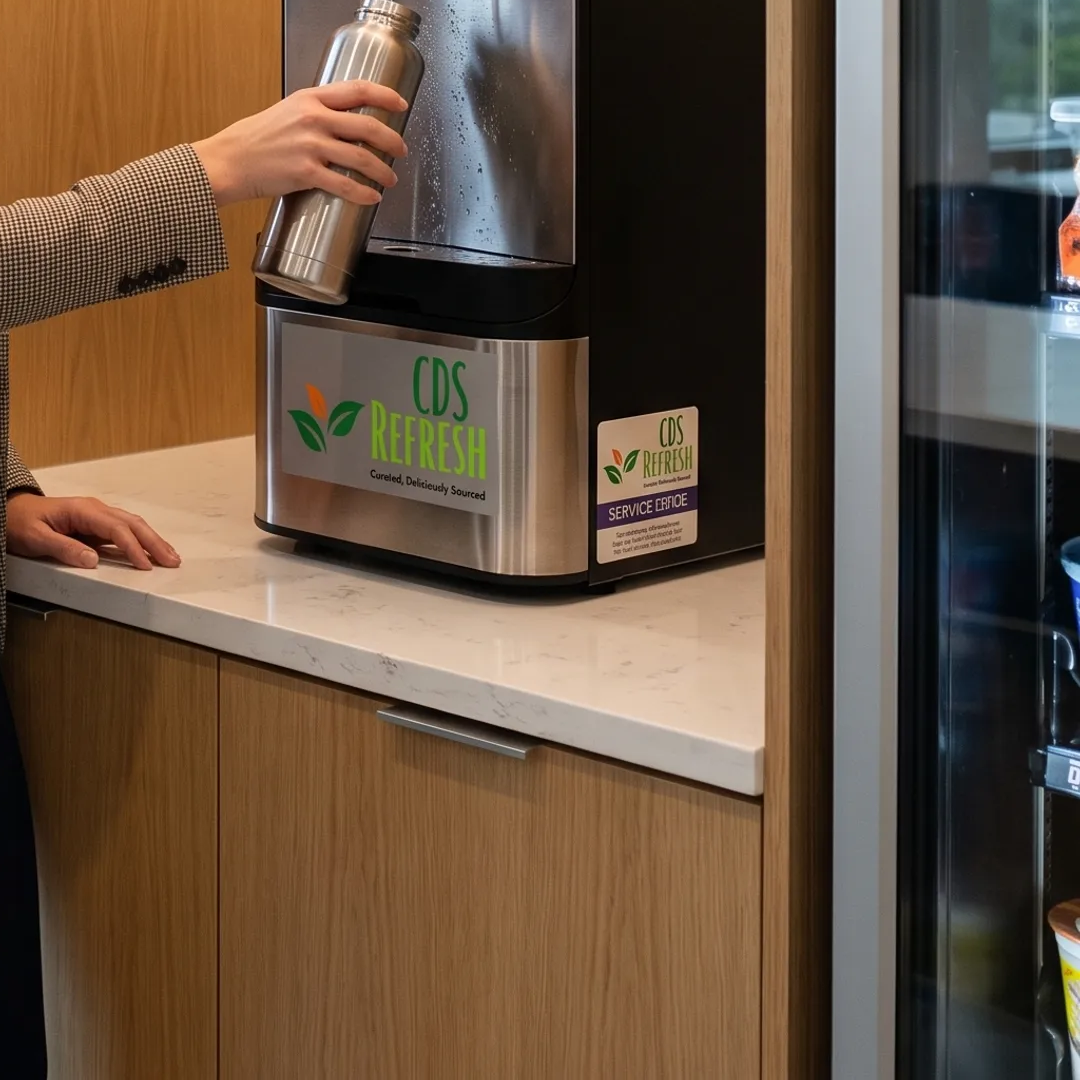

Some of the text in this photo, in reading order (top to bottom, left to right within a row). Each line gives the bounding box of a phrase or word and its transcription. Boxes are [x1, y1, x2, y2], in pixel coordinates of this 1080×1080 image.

[413, 356, 469, 422] CDS
[370, 399, 487, 481] REFRESH
[659, 414, 684, 448] CDS
[643, 445, 693, 479] REFRESH
[450, 485, 486, 501] Sourced
[608, 499, 653, 522] SERVICE
